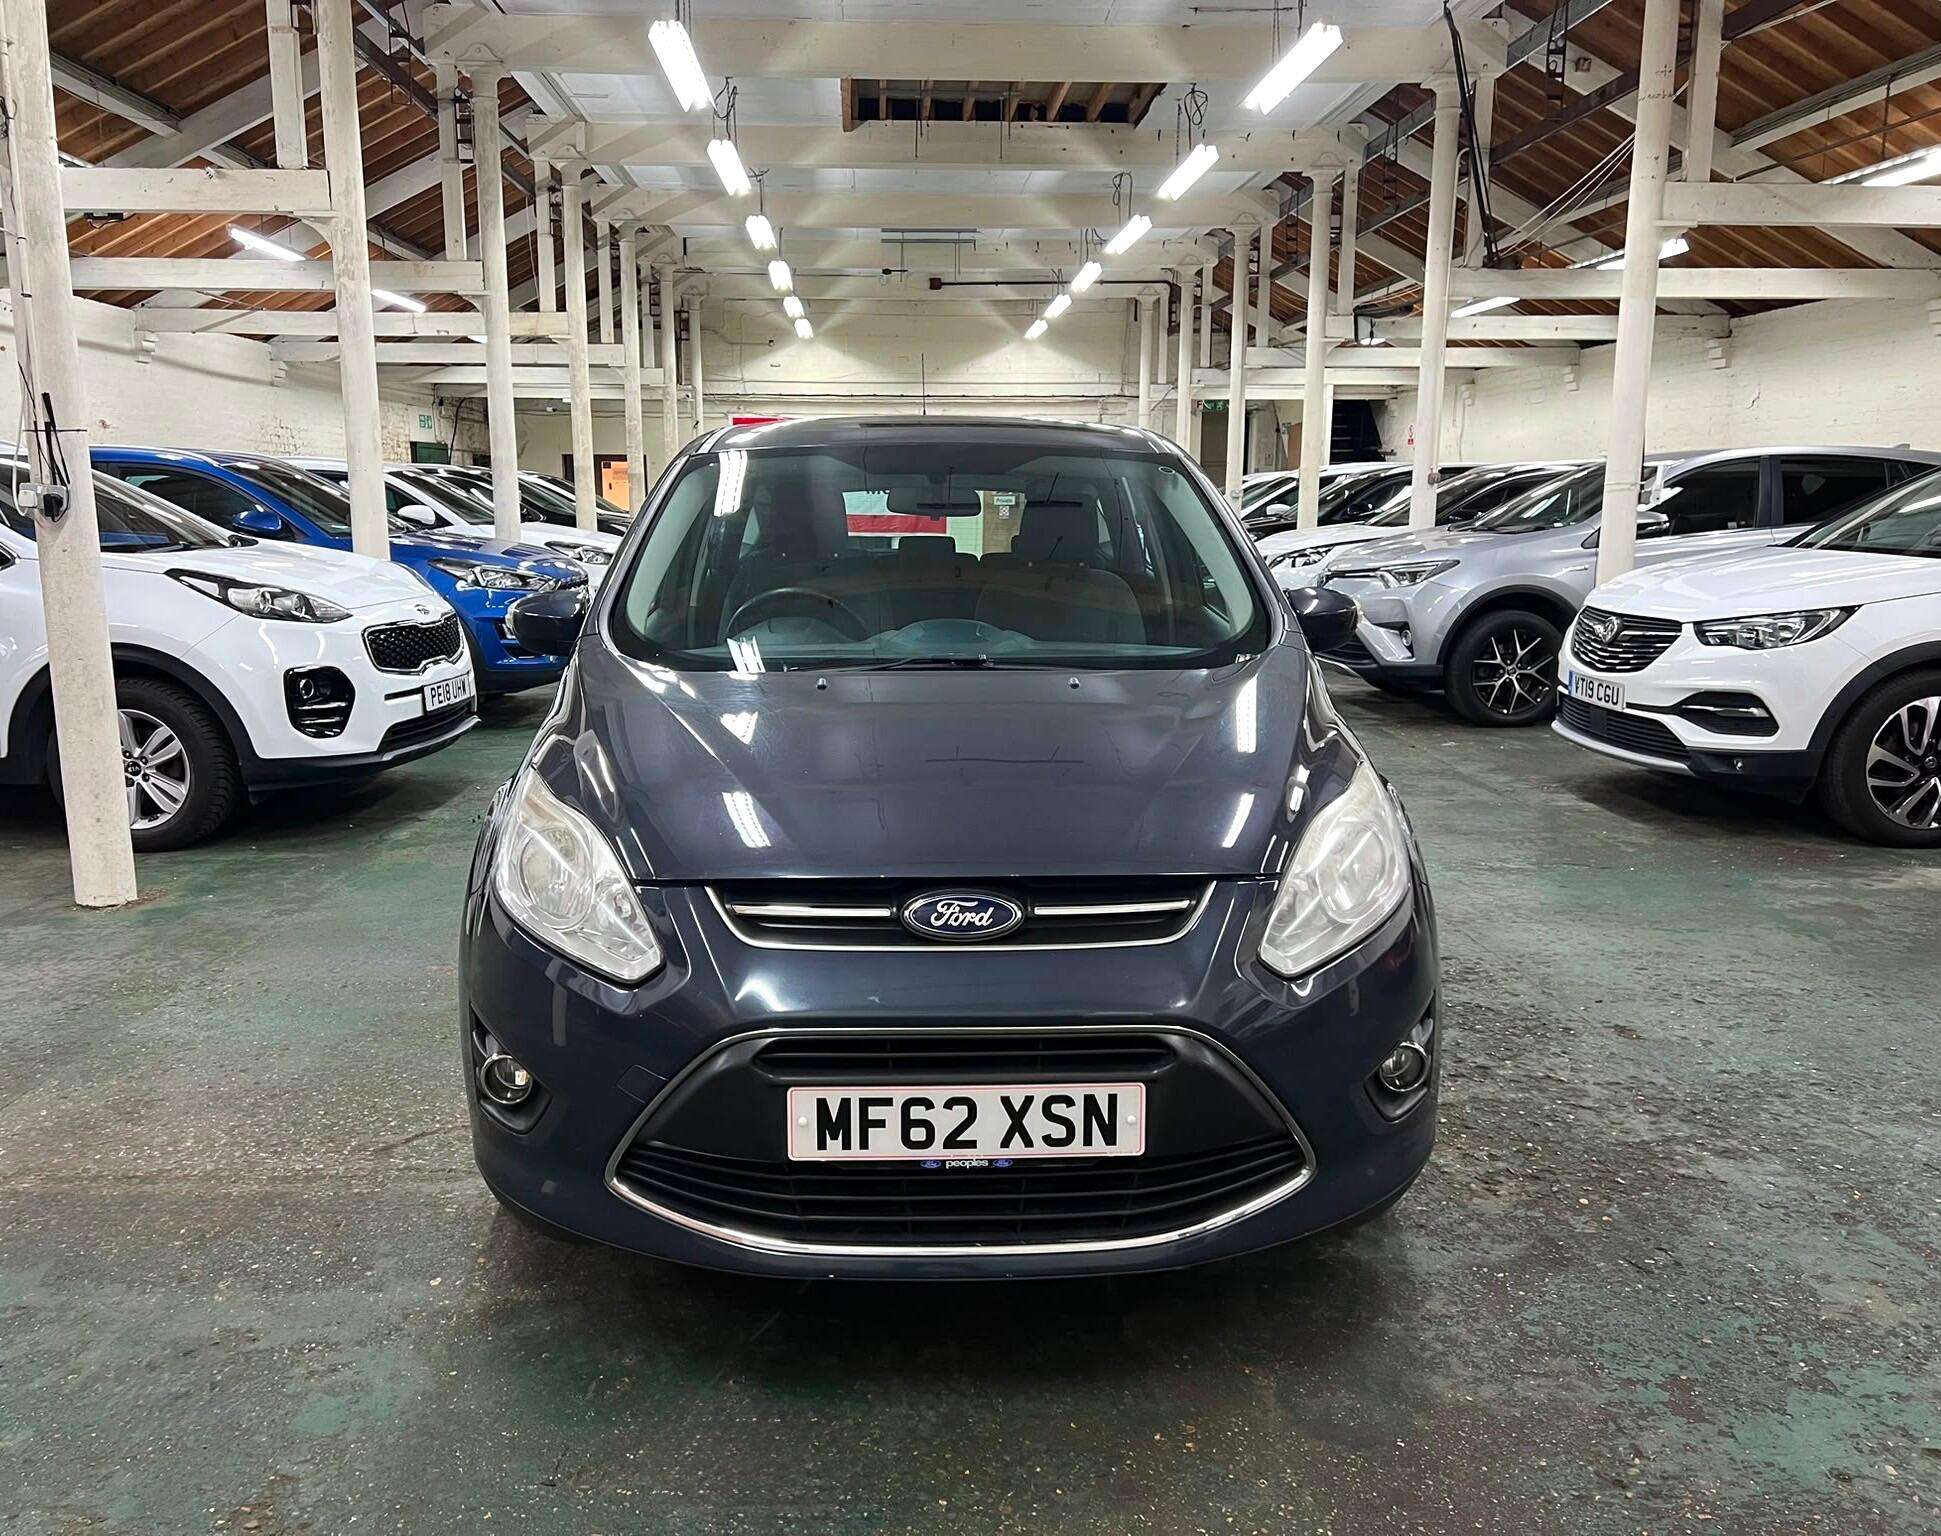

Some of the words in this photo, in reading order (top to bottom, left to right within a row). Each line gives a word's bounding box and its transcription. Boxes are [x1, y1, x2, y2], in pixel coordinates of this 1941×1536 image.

[430, 683, 451, 706] PE18
[1596, 683, 1620, 706] CGU
[930, 900, 995, 927] Ford
[815, 1096, 978, 1151] MF62
[999, 1093, 1118, 1150] XSN
[945, 1158, 989, 1169] peoples
